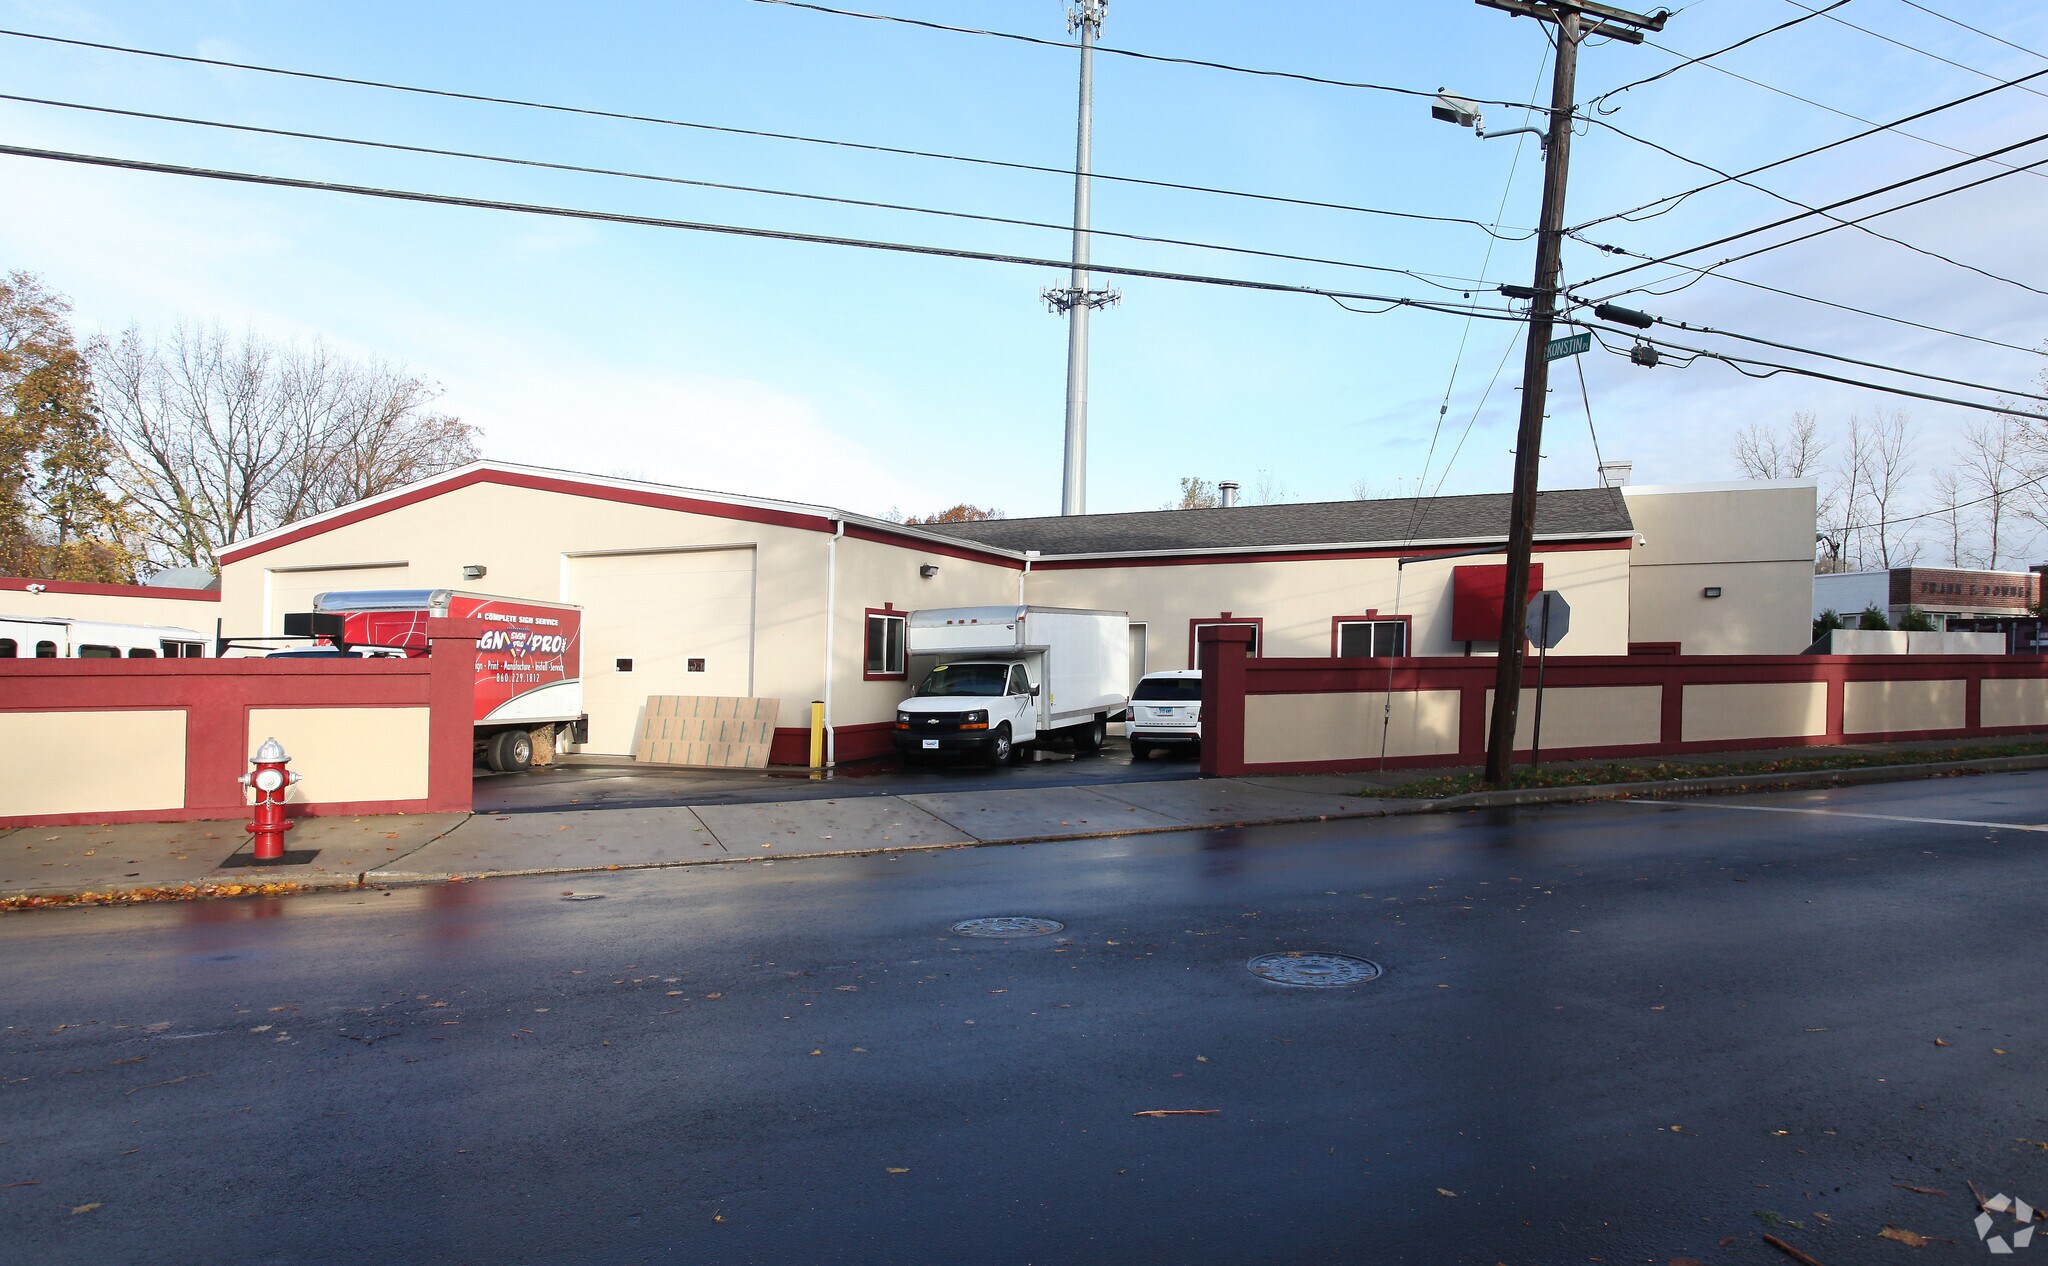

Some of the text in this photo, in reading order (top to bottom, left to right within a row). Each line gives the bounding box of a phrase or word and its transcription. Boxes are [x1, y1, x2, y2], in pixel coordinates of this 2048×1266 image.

[1547, 337, 1583, 358] KONSTIN
[484, 612, 517, 623] COMPLETE
[519, 616, 534, 624] SIGN
[535, 617, 559, 626] SERVICE
[476, 631, 506, 650] IGN
[511, 632, 527, 640] SIGN
[513, 640, 525, 648] PRO
[487, 660, 499, 670] Print
[503, 660, 531, 671] Manufacture
[535, 661, 549, 671] Install
